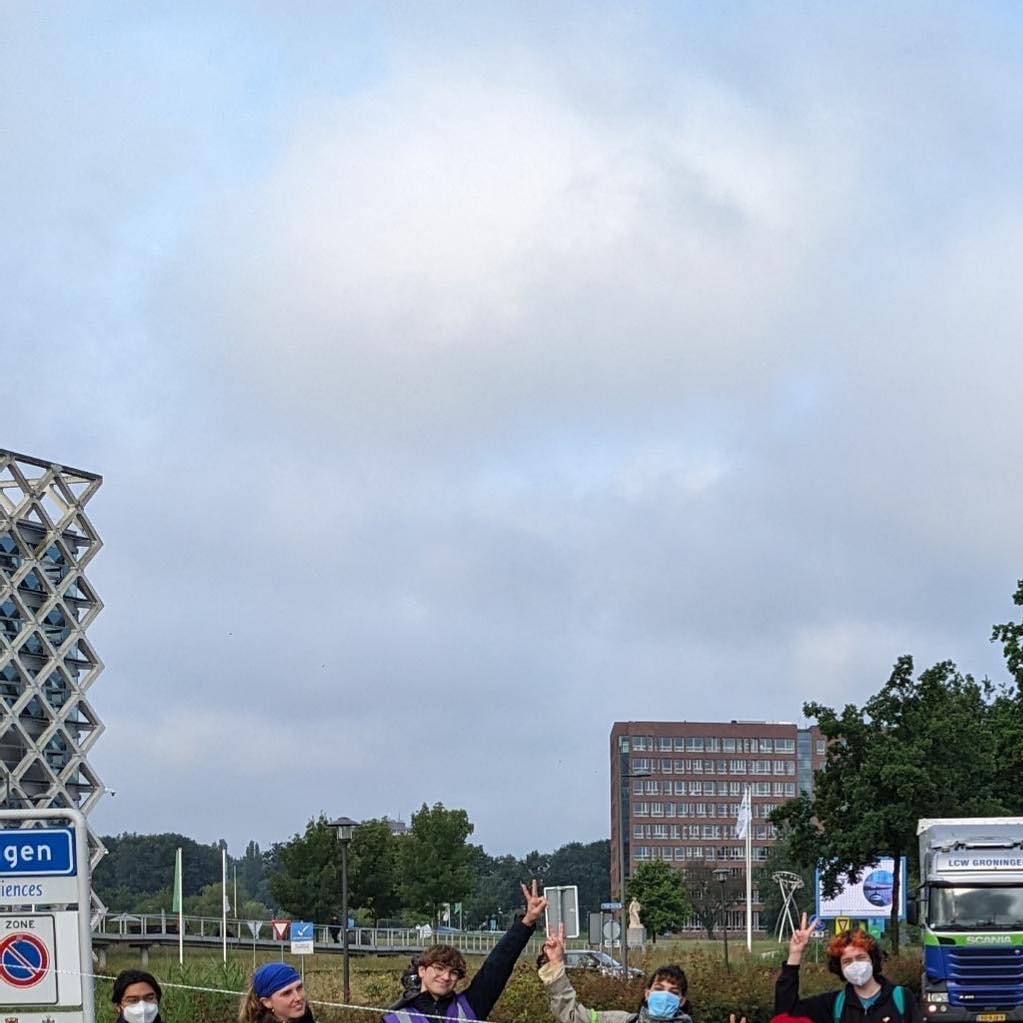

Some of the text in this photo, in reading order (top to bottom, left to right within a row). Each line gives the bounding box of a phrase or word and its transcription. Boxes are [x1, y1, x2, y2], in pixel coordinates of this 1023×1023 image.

[3, 844, 52, 869] gen
[948, 859, 970, 867] LCW
[5, 920, 36, 929] ZONE
[966, 936, 1012, 944] SCANIA
